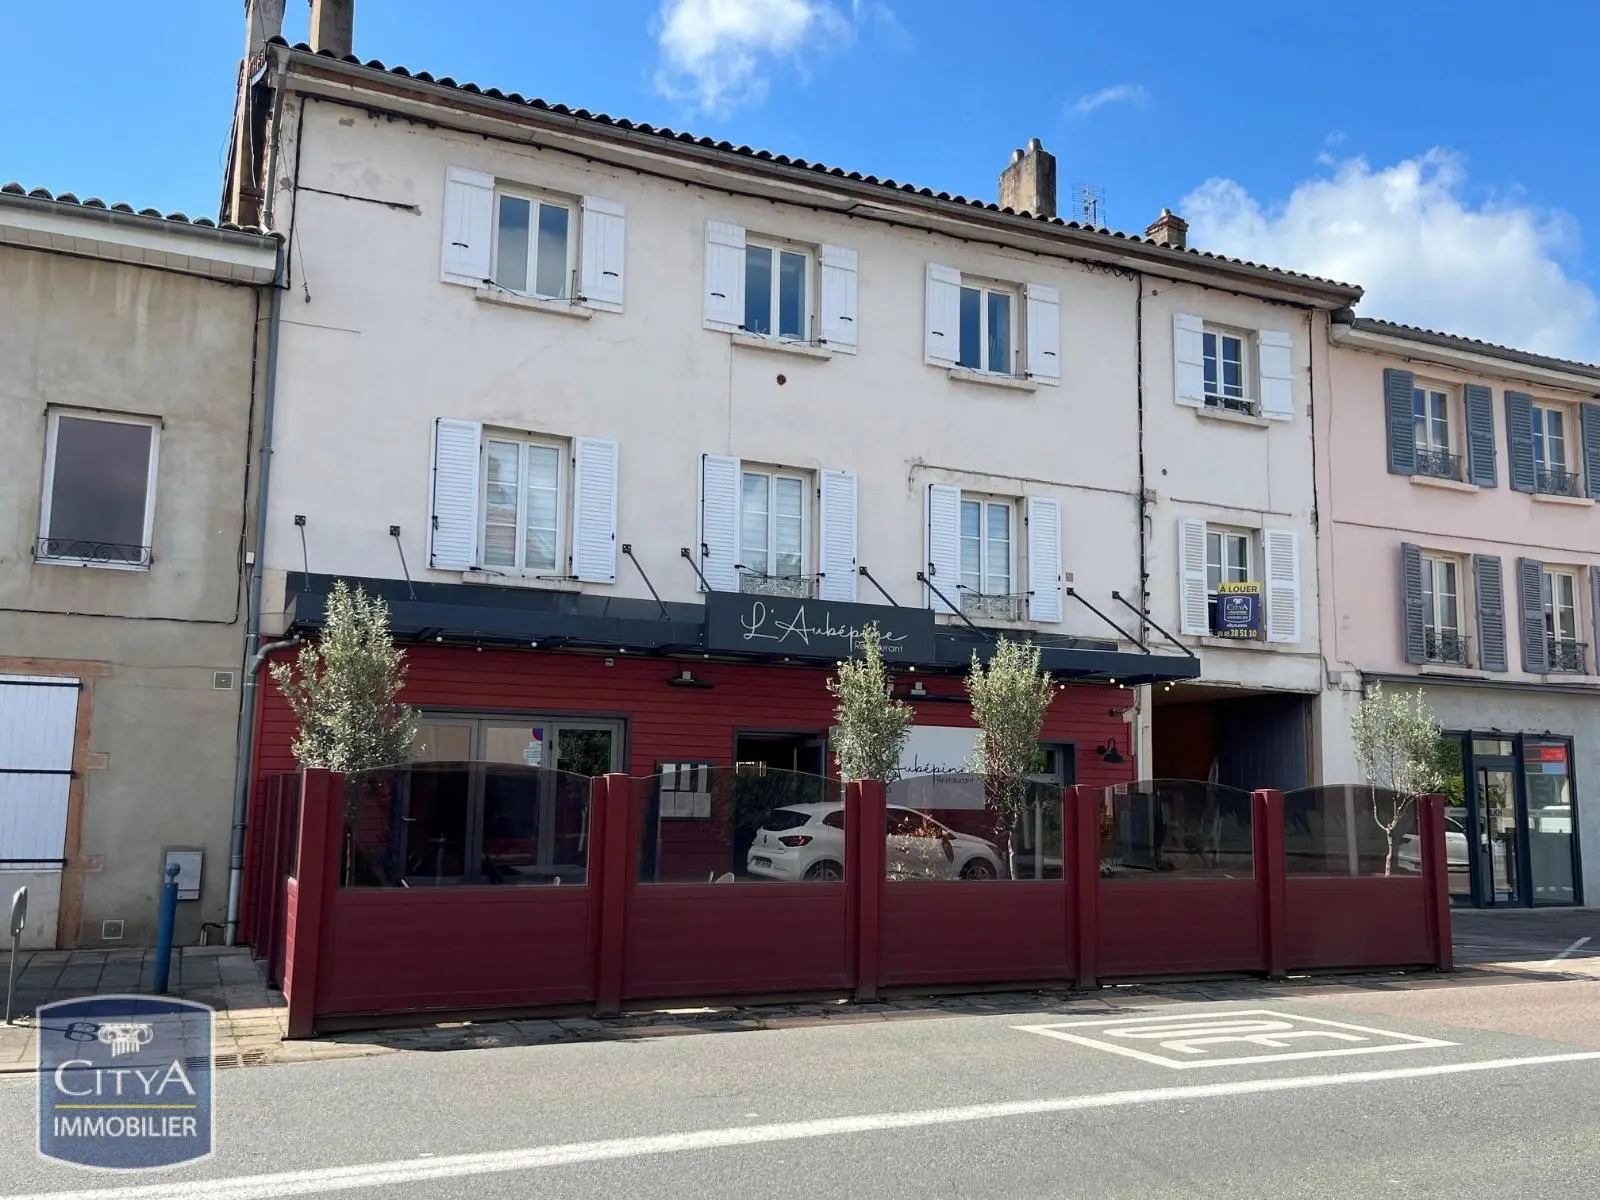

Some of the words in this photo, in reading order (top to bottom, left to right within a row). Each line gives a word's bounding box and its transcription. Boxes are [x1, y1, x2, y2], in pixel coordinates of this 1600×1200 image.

[740, 601, 908, 651] L'Aubépe
[1240, 629, 1248, 637] 51
[1249, 629, 1257, 637] 10
[936, 775, 974, 784] Restaurant
